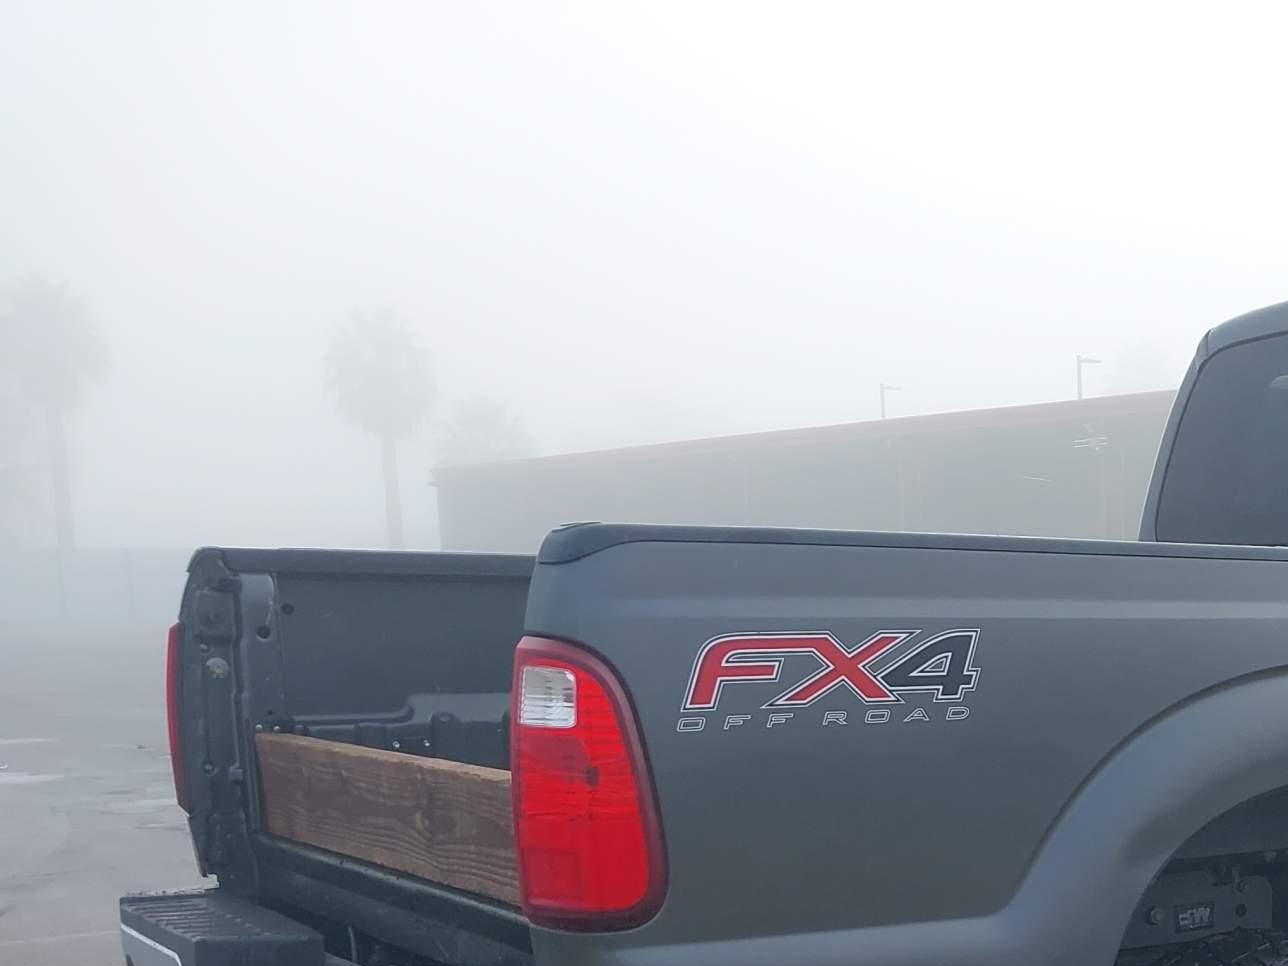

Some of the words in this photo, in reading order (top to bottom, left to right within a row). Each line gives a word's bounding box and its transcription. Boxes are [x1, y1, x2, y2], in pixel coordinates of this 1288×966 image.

[680, 628, 982, 712] FX4
[676, 712, 794, 732] OFF
[822, 706, 971, 726] ROAD
